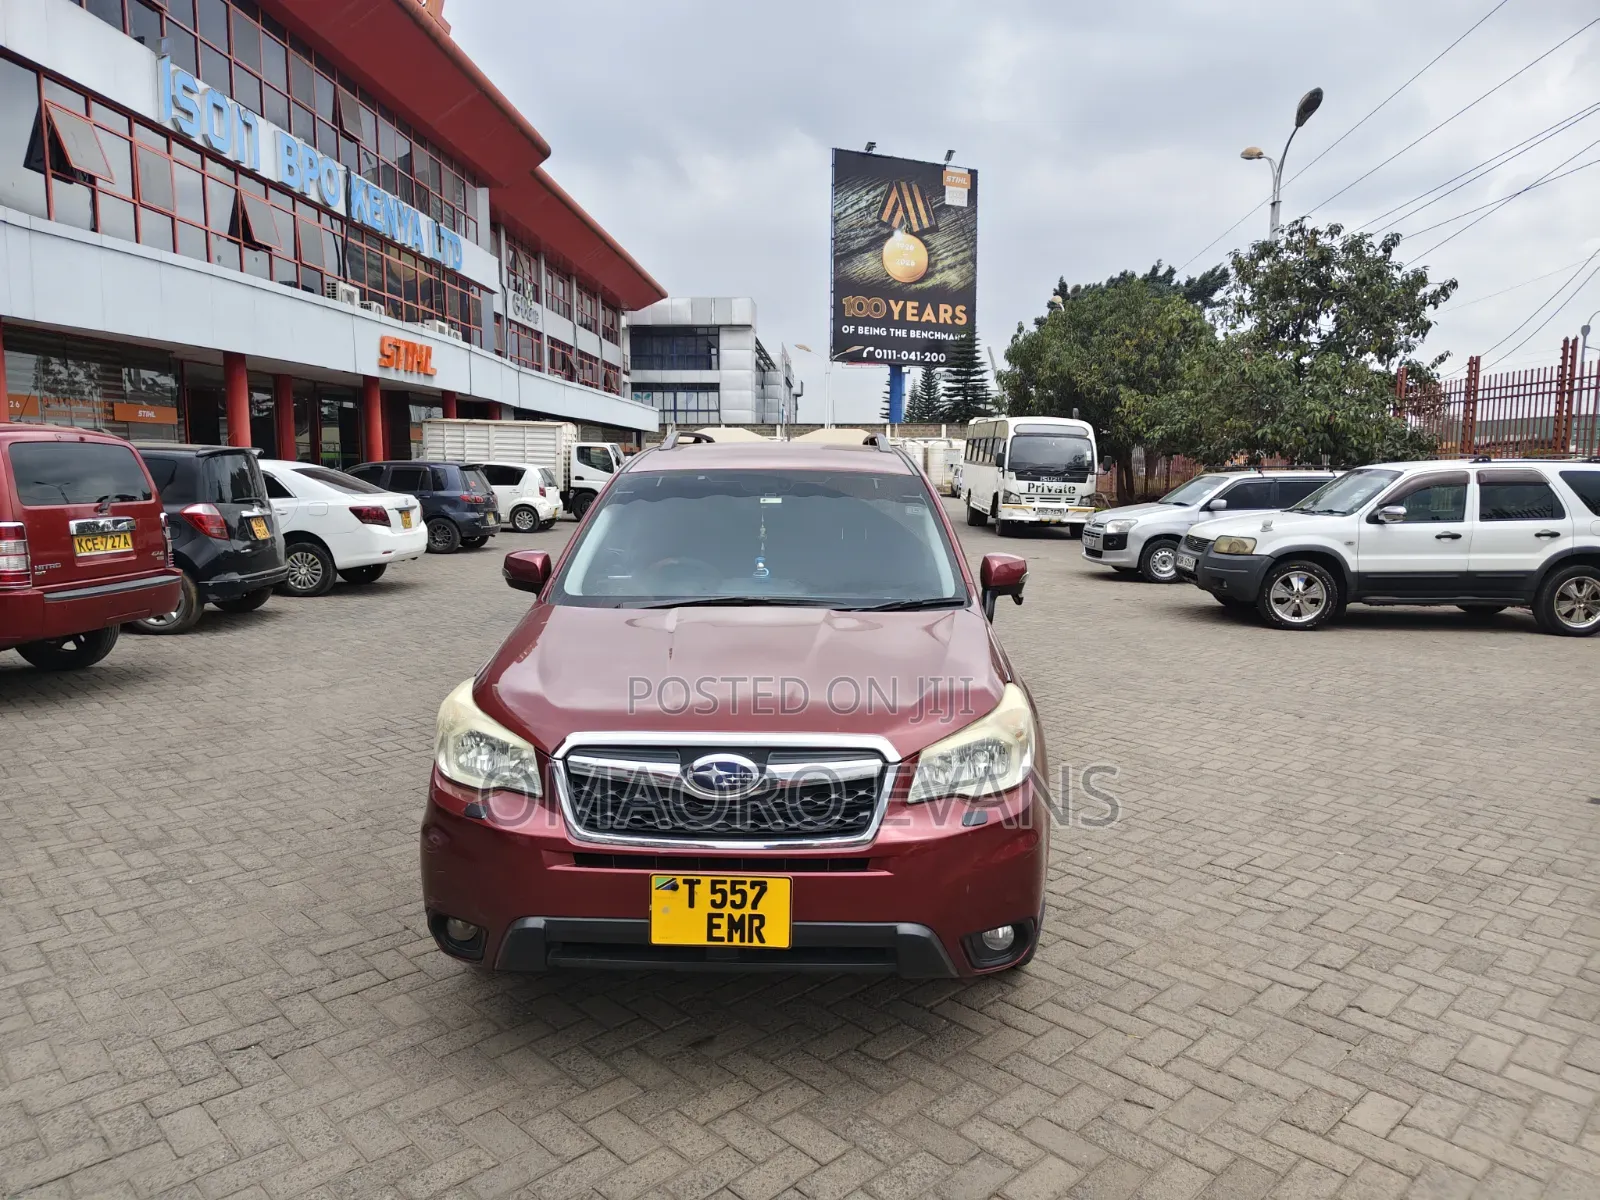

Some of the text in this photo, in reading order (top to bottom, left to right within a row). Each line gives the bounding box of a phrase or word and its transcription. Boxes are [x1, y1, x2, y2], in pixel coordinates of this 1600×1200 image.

[945, 175, 968, 185] STIHL
[275, 130, 340, 208] BPO
[350, 174, 425, 253] KENYA
[427, 220, 463, 271] LTD
[842, 295, 968, 326] 100 YEARS
[842, 325, 855, 334] OF
[858, 326, 887, 336] BEING
[889, 328, 908, 338] THE
[378, 335, 437, 377] STIHL
[874, 348, 947, 363] 0111-041-200
[137, 409, 156, 418] STIHL
[1027, 482, 1076, 494] Private
[77, 533, 131, 552] KCE 727A
[34, 562, 62, 571] NITRO
[682, 878, 768, 910] T 557
[706, 912, 766, 944] EMR
